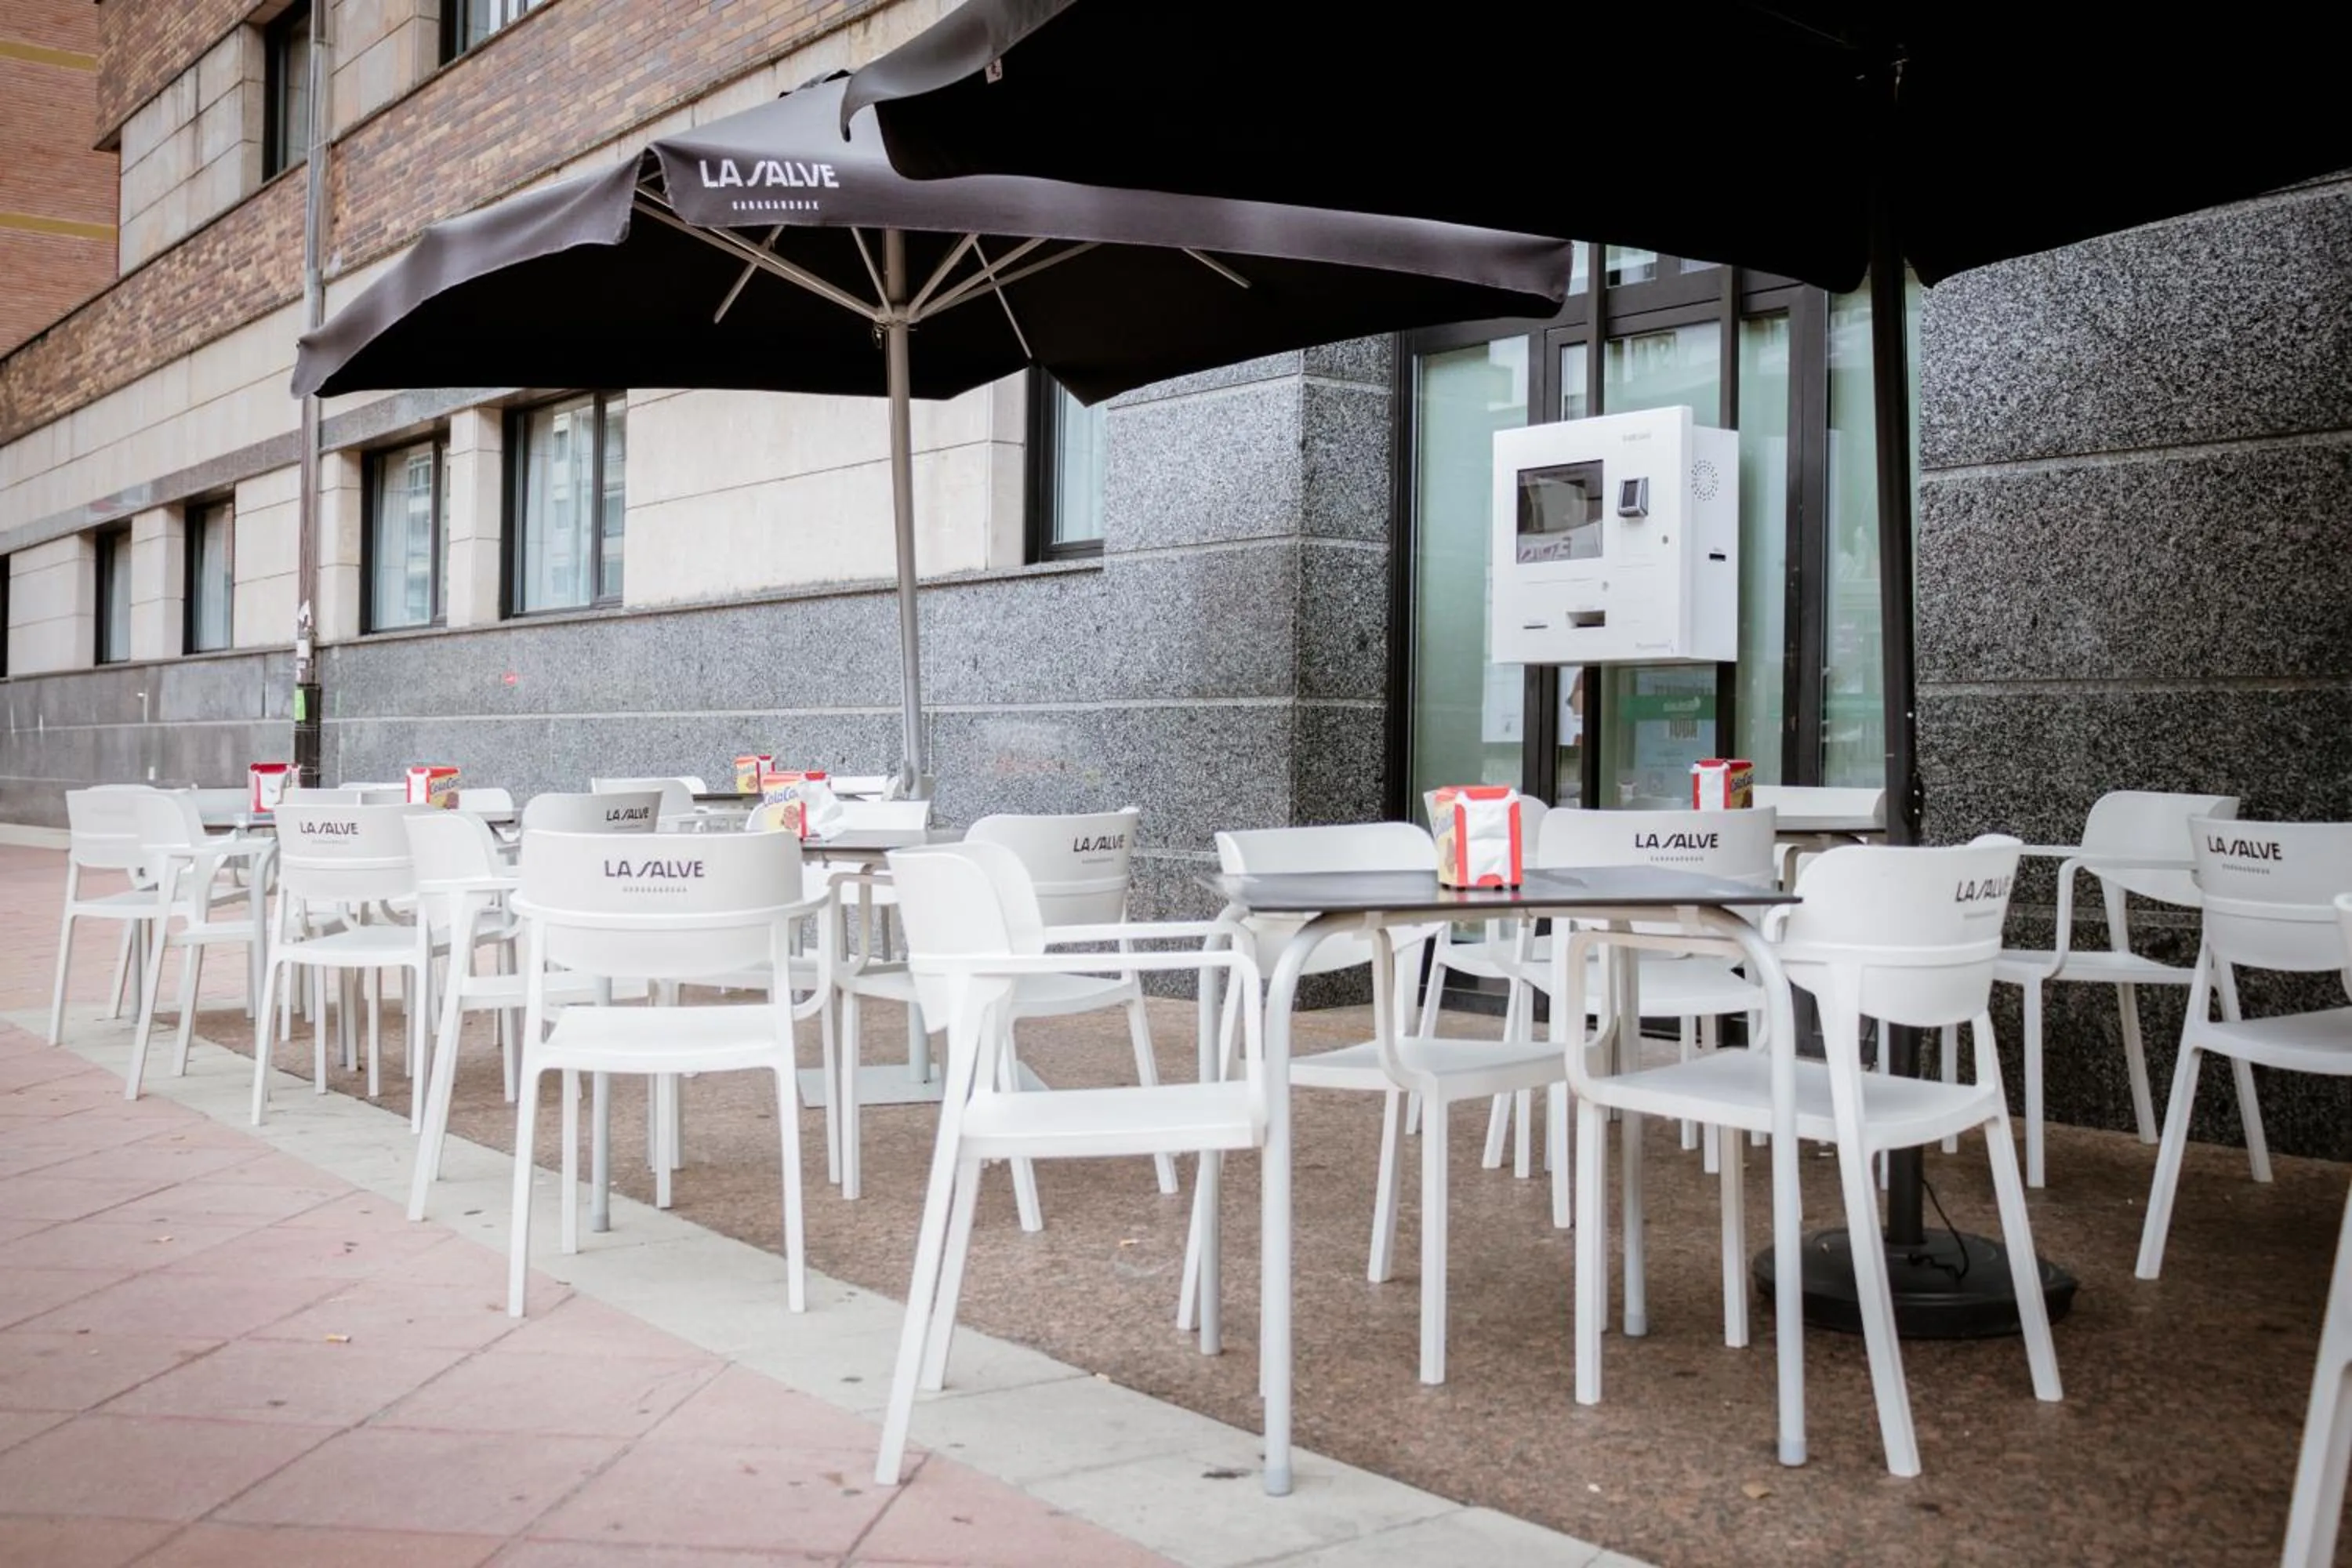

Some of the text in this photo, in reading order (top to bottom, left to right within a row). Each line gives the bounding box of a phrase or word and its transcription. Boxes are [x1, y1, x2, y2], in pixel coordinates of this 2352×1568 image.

[699, 158, 840, 188] LA SALVE
[300, 822, 359, 835] LA SALVE
[1635, 833, 1719, 849] LA SALVE
[2207, 834, 2283, 861] LA SALVE
[604, 860, 705, 878] LA SALVE
